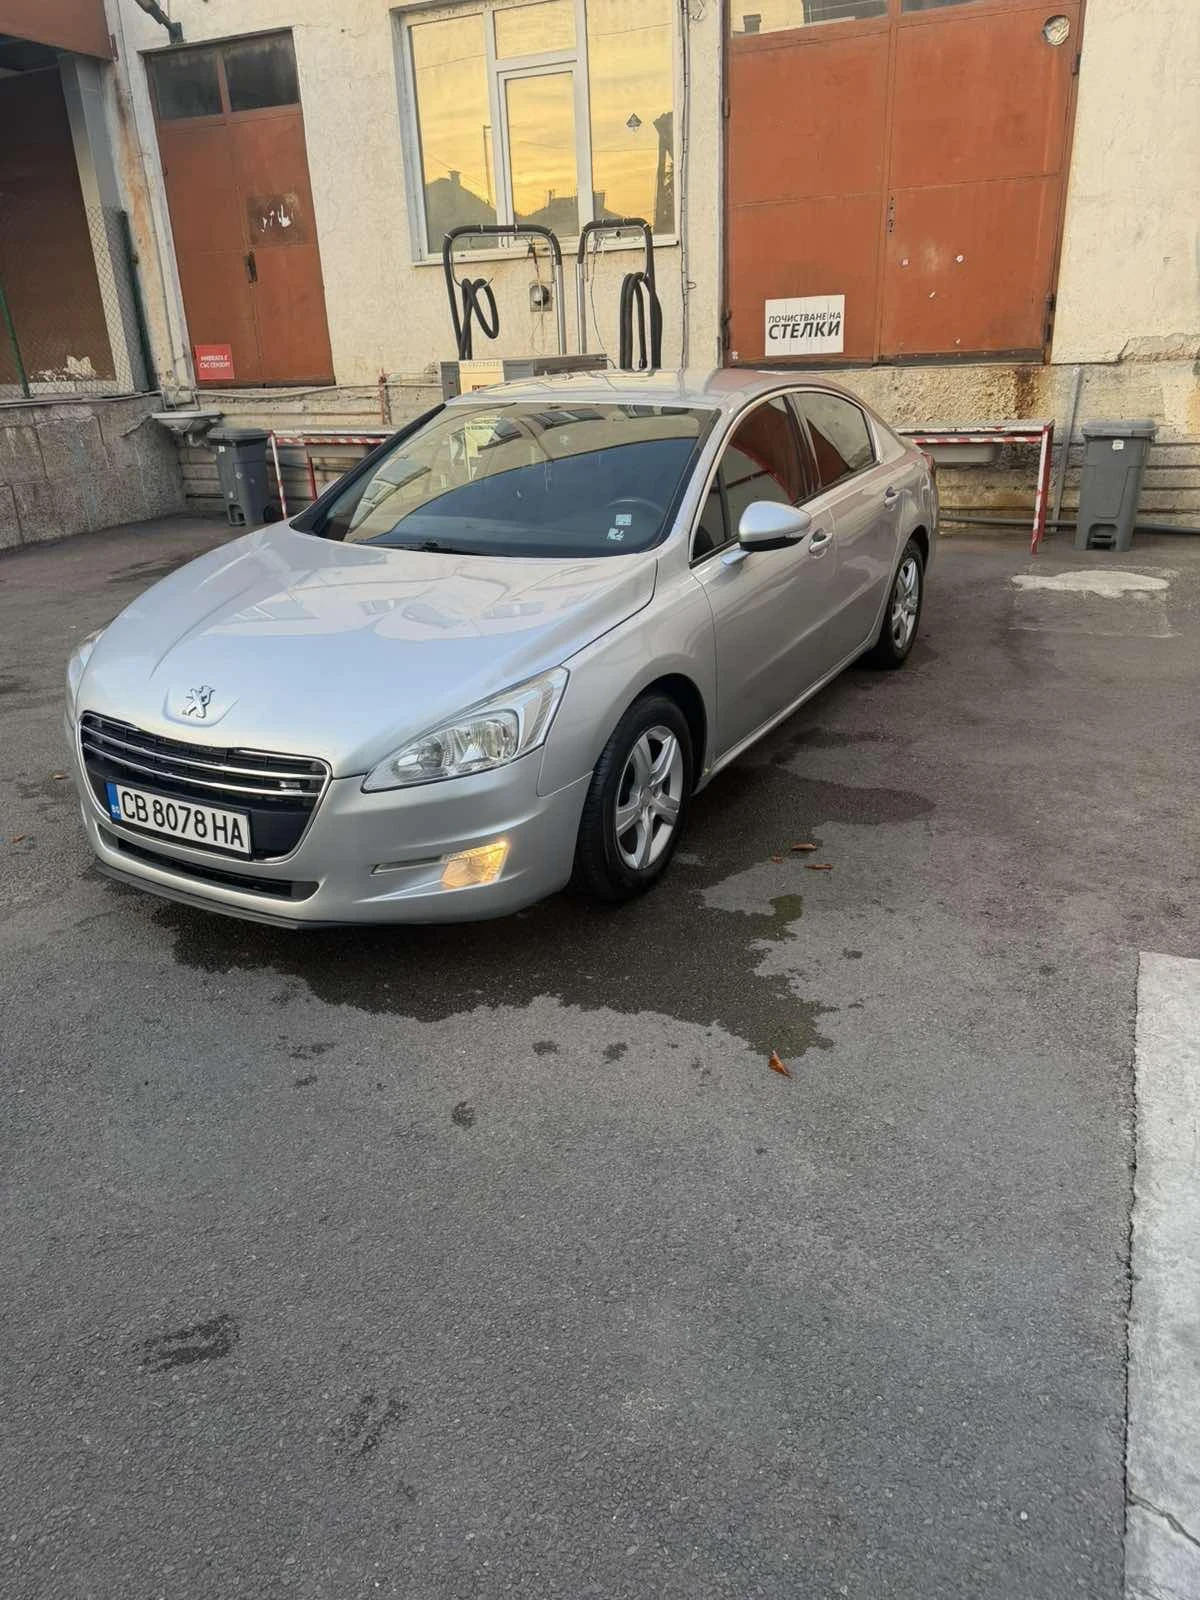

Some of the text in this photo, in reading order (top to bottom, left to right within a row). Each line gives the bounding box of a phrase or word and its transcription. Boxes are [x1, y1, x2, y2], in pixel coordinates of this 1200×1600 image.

[768, 311, 841, 323] ПОЧИСТВАНЕ НА
[768, 320, 840, 339] СТЕЛКИ
[121, 791, 244, 848] CB 8078 HA
